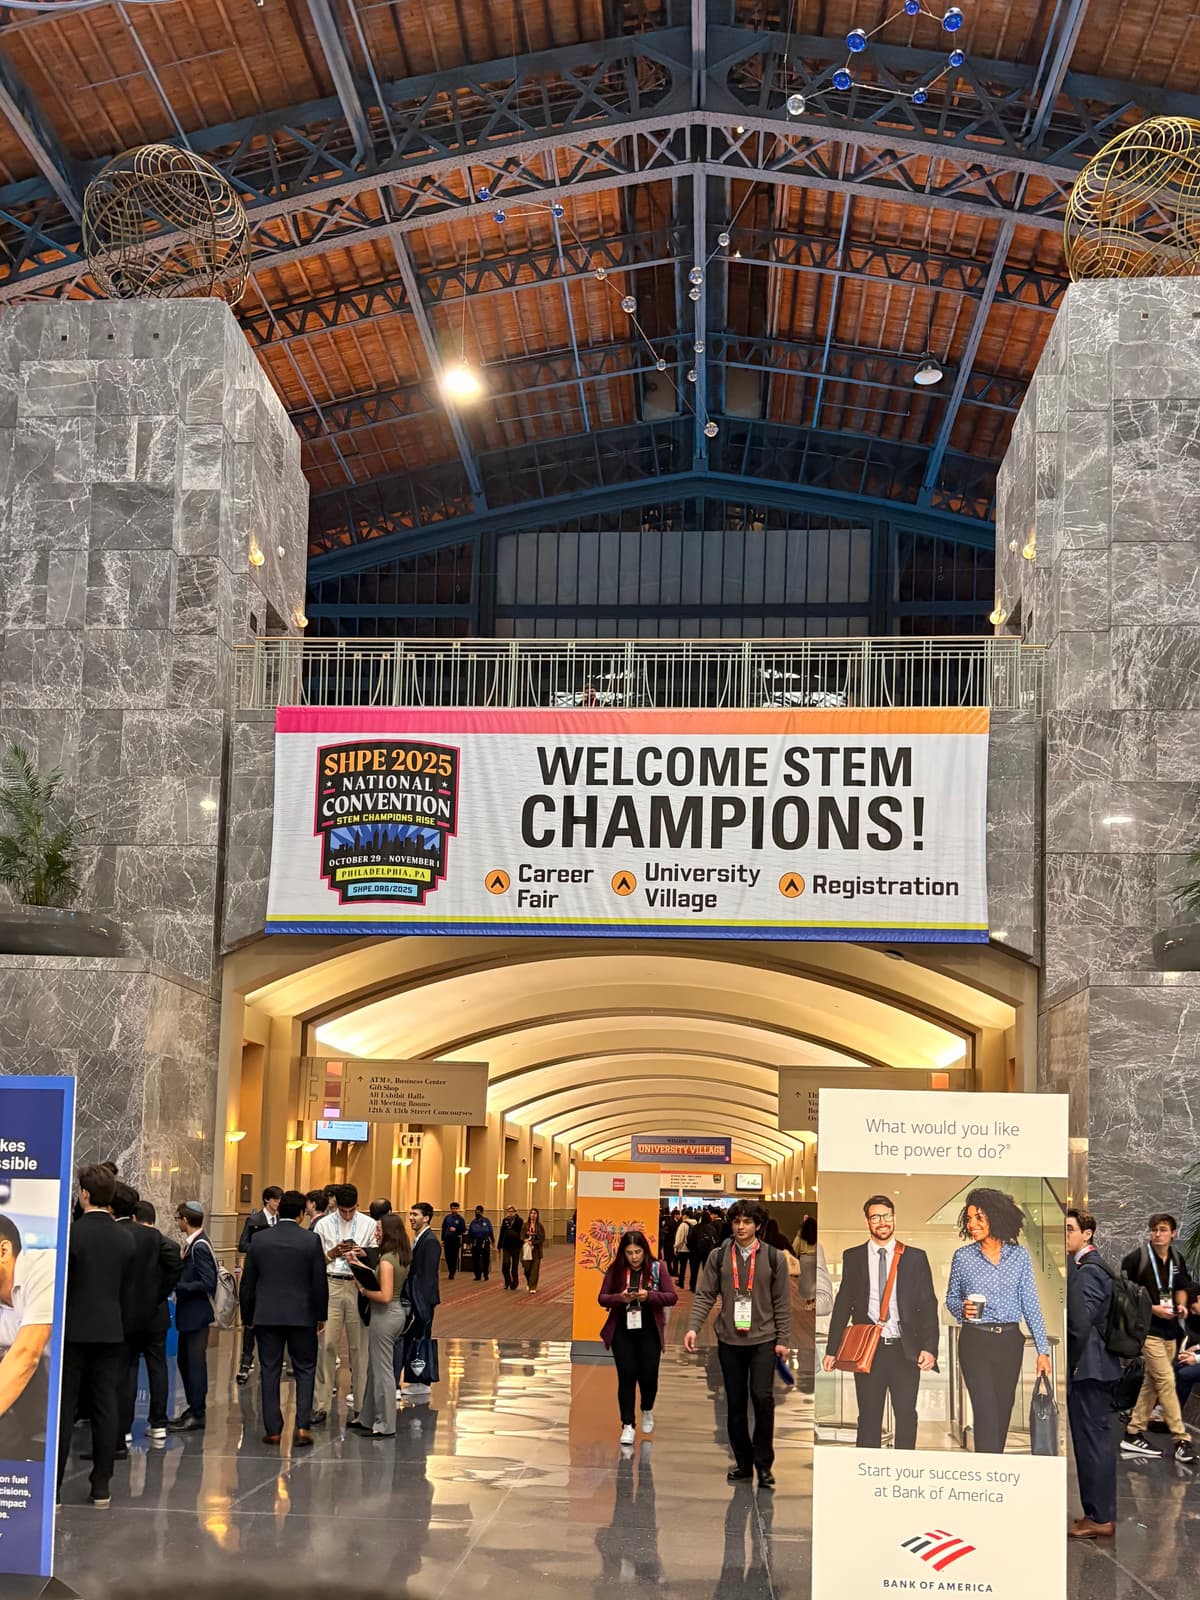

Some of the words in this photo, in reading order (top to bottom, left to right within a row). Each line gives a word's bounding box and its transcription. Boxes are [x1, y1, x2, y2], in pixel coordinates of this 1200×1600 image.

[324, 748, 388, 776] SHPE
[391, 749, 452, 777] 2025
[536, 746, 768, 787] WELCOME
[783, 746, 912, 787] STEM
[342, 774, 434, 792] NATIONAL
[322, 792, 451, 819] CONVENTION
[336, 814, 360, 825] STEM
[362, 813, 413, 823] CHAMPIONS
[415, 815, 436, 826] RISE
[521, 794, 925, 851] CHAMPIONS!
[328, 855, 369, 867] OCTOBER
[370, 854, 381, 863] 29
[388, 854, 435, 868] NOVEMBER
[436, 860, 440, 868] 1
[341, 867, 412, 879] PHILADELPHIA,
[414, 871, 426, 880] PA
[518, 863, 595, 883] Career
[645, 862, 761, 888] University
[352, 884, 413, 895] SHPE.ORG/2025
[812, 874, 959, 899] Registration
[517, 889, 559, 908] Fair
[645, 887, 718, 912] Village
[369, 1083, 382, 1091] Gift
[383, 1084, 400, 1093] Shop
[394, 1077, 423, 1085] Business
[424, 1078, 447, 1086] Center
[380, 1091, 405, 1099] Exhibit
[407, 1092, 425, 1100] Halls
[380, 1099, 407, 1107] Meeting
[368, 1106, 384, 1114] 12th
[410, 1107, 431, 1116] Street
[433, 1108, 473, 1117] Concourses
[866, 1118, 906, 1133] What
[911, 1119, 956, 1135] would
[961, 1124, 989, 1139] you
[994, 1120, 1020, 1137] like
[637, 1143, 690, 1155] UNIVERSITY
[690, 1144, 726, 1156] VILLAGE
[874, 1140, 899, 1156] the
[904, 1145, 952, 1160] power
[957, 1144, 972, 1158] to
[12, 1475, 28, 1484] fuel
[858, 1463, 892, 1477] Start
[895, 1467, 925, 1481] your
[929, 1469, 982, 1482] success
[986, 1471, 1020, 1486] story
[874, 1486, 889, 1498] at
[892, 1484, 925, 1499] Bank
[929, 1486, 944, 1500] of
[948, 1487, 1004, 1503] America
[883, 1579, 916, 1589] BANK
[920, 1580, 935, 1590] OF
[937, 1582, 993, 1593] AMERICA
